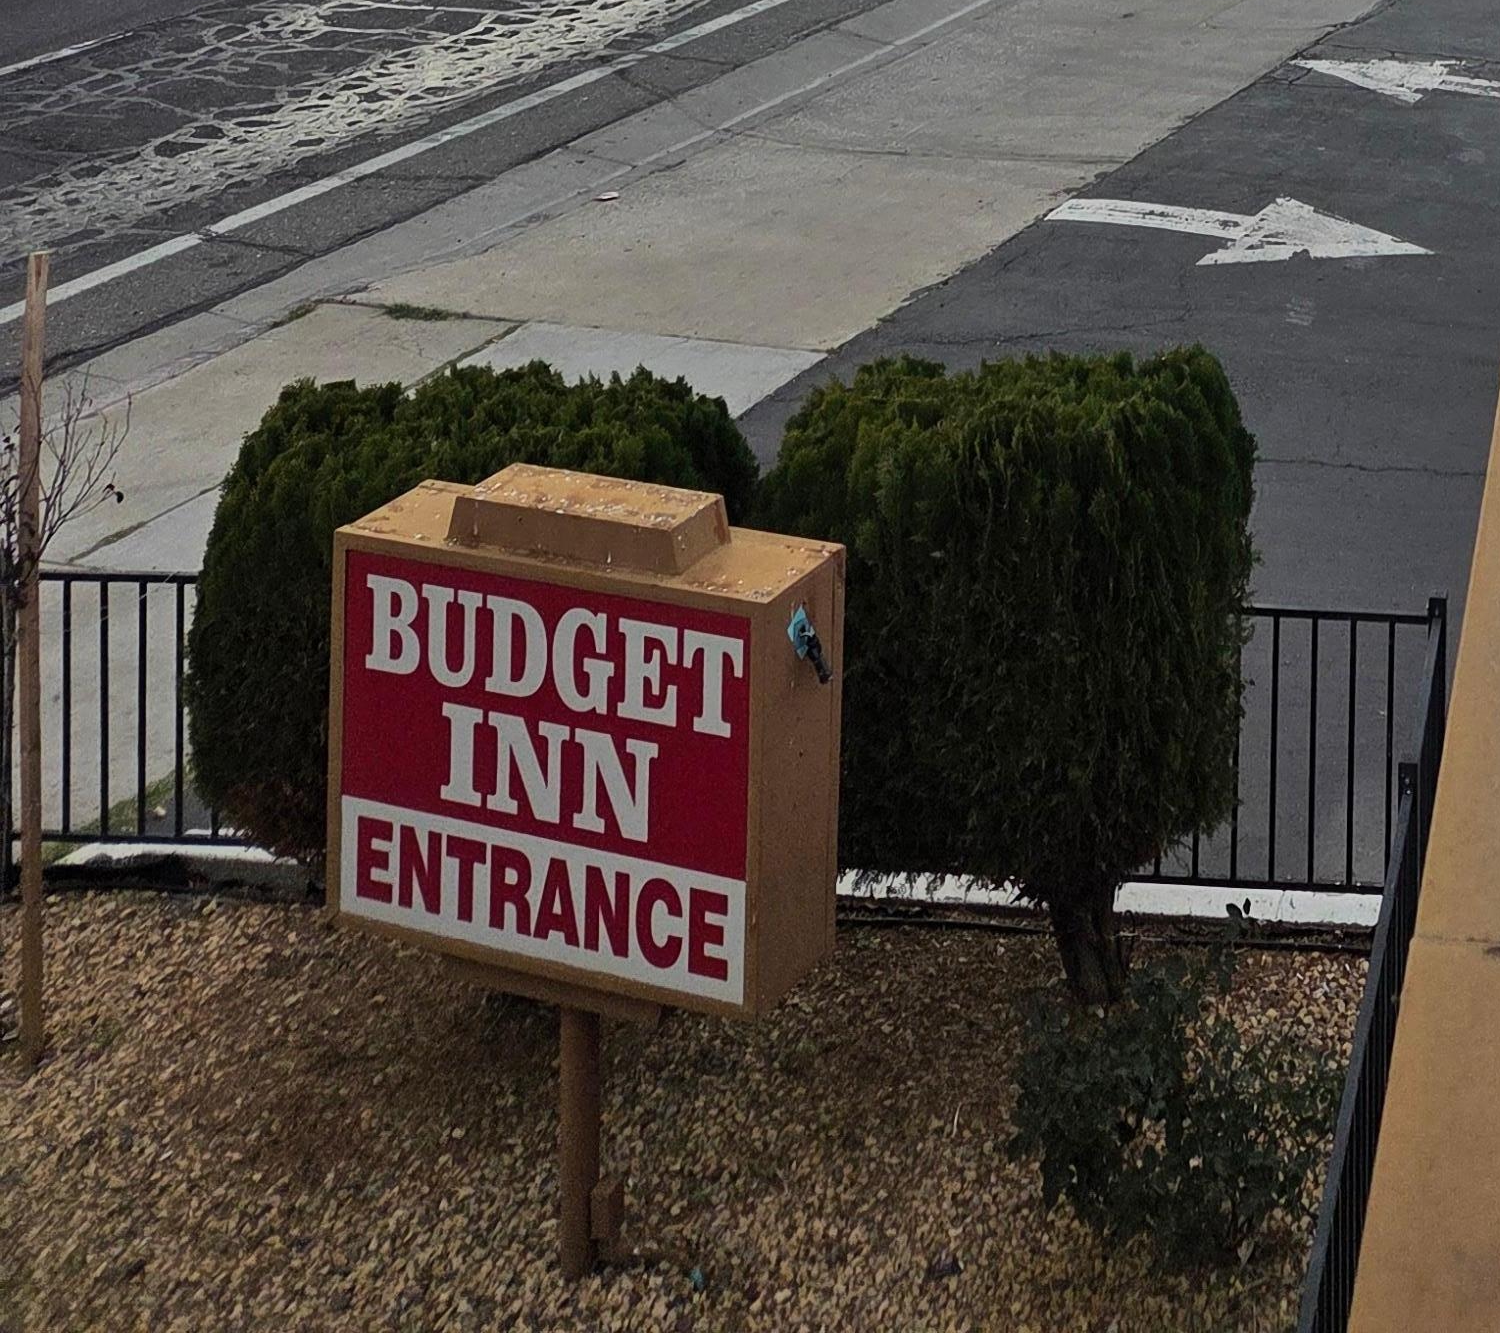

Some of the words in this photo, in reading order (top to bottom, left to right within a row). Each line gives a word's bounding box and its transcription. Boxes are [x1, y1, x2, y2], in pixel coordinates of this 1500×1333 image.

[364, 573, 744, 739] BUDGET
[439, 702, 659, 843] INN
[356, 815, 729, 982] ENTRANCE
